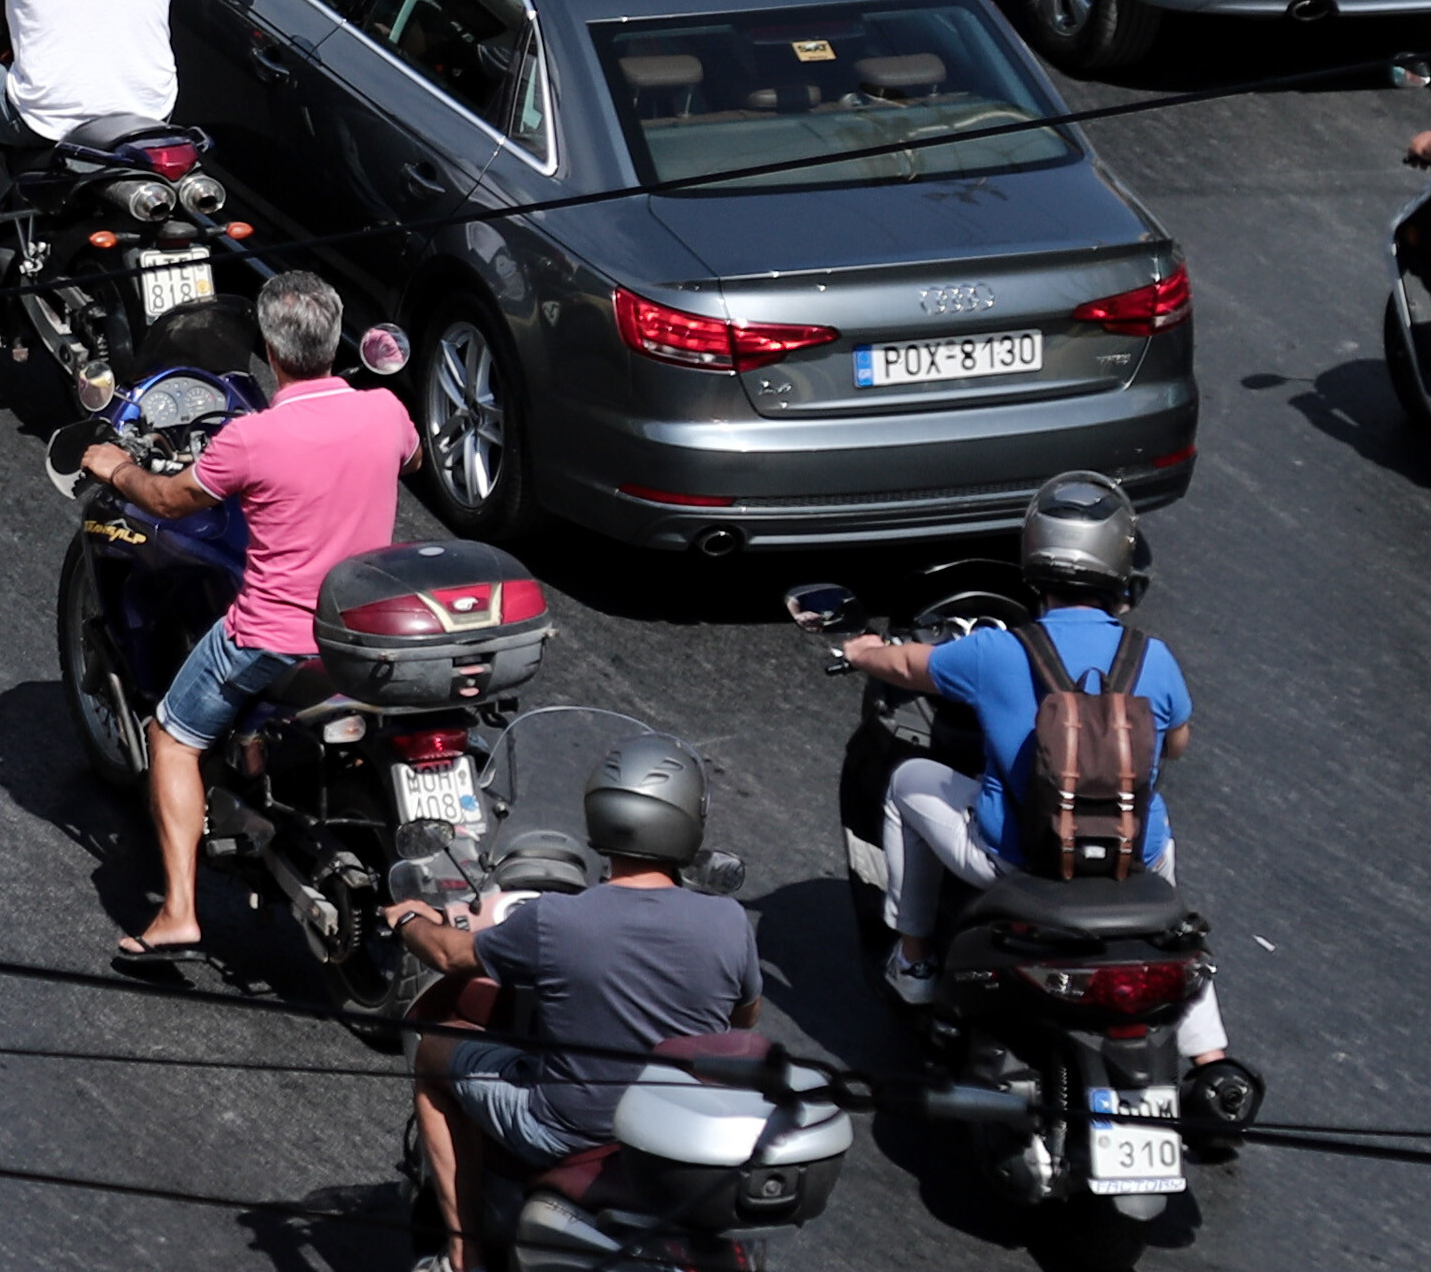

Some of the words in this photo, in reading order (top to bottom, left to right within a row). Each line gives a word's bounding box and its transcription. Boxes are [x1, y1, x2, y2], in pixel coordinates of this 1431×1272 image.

[152, 284, 192, 310] 818
[884, 334, 1036, 378] POX-8130
[1119, 1140, 1175, 1168] 310
